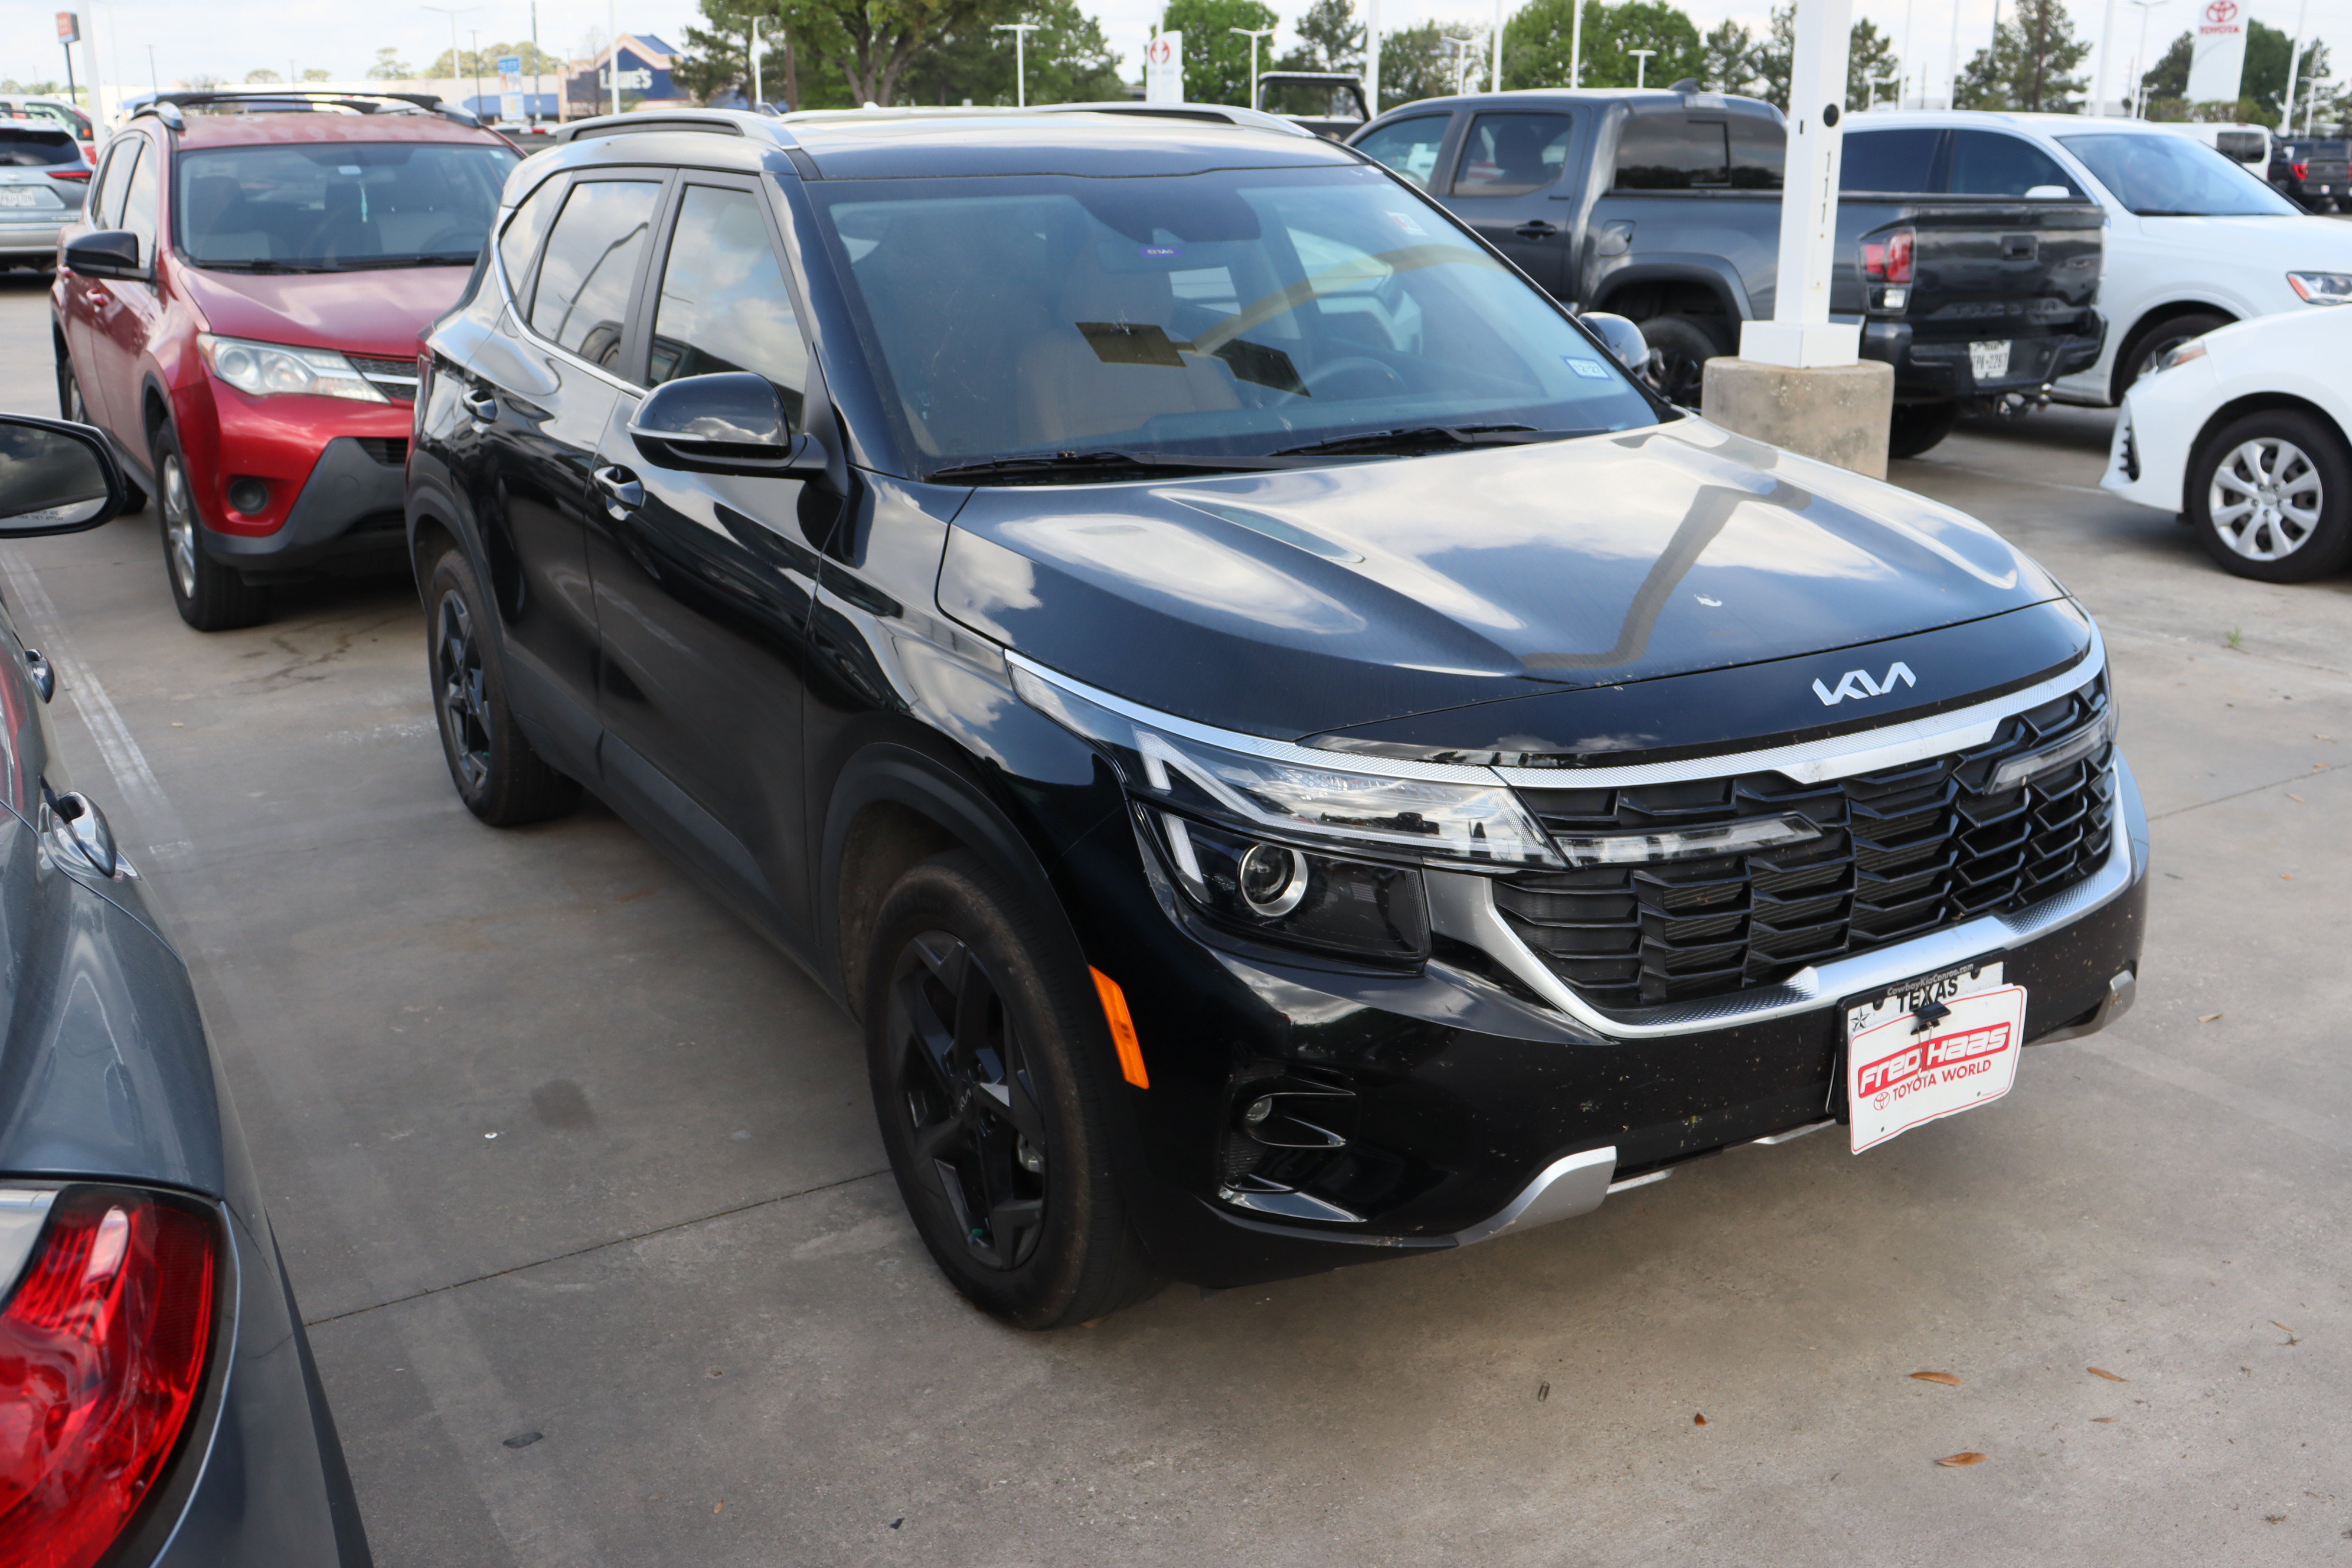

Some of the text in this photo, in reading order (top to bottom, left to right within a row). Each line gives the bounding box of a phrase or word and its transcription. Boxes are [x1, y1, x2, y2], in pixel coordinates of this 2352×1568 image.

[2200, 25, 2241, 34] TOYOTA
[599, 67, 652, 89] LWE'S
[1812, 661, 1917, 706] KIA
[1896, 976, 1959, 1013] TEXAS
[1893, 1059, 1992, 1102] TOYOTA WORLD
